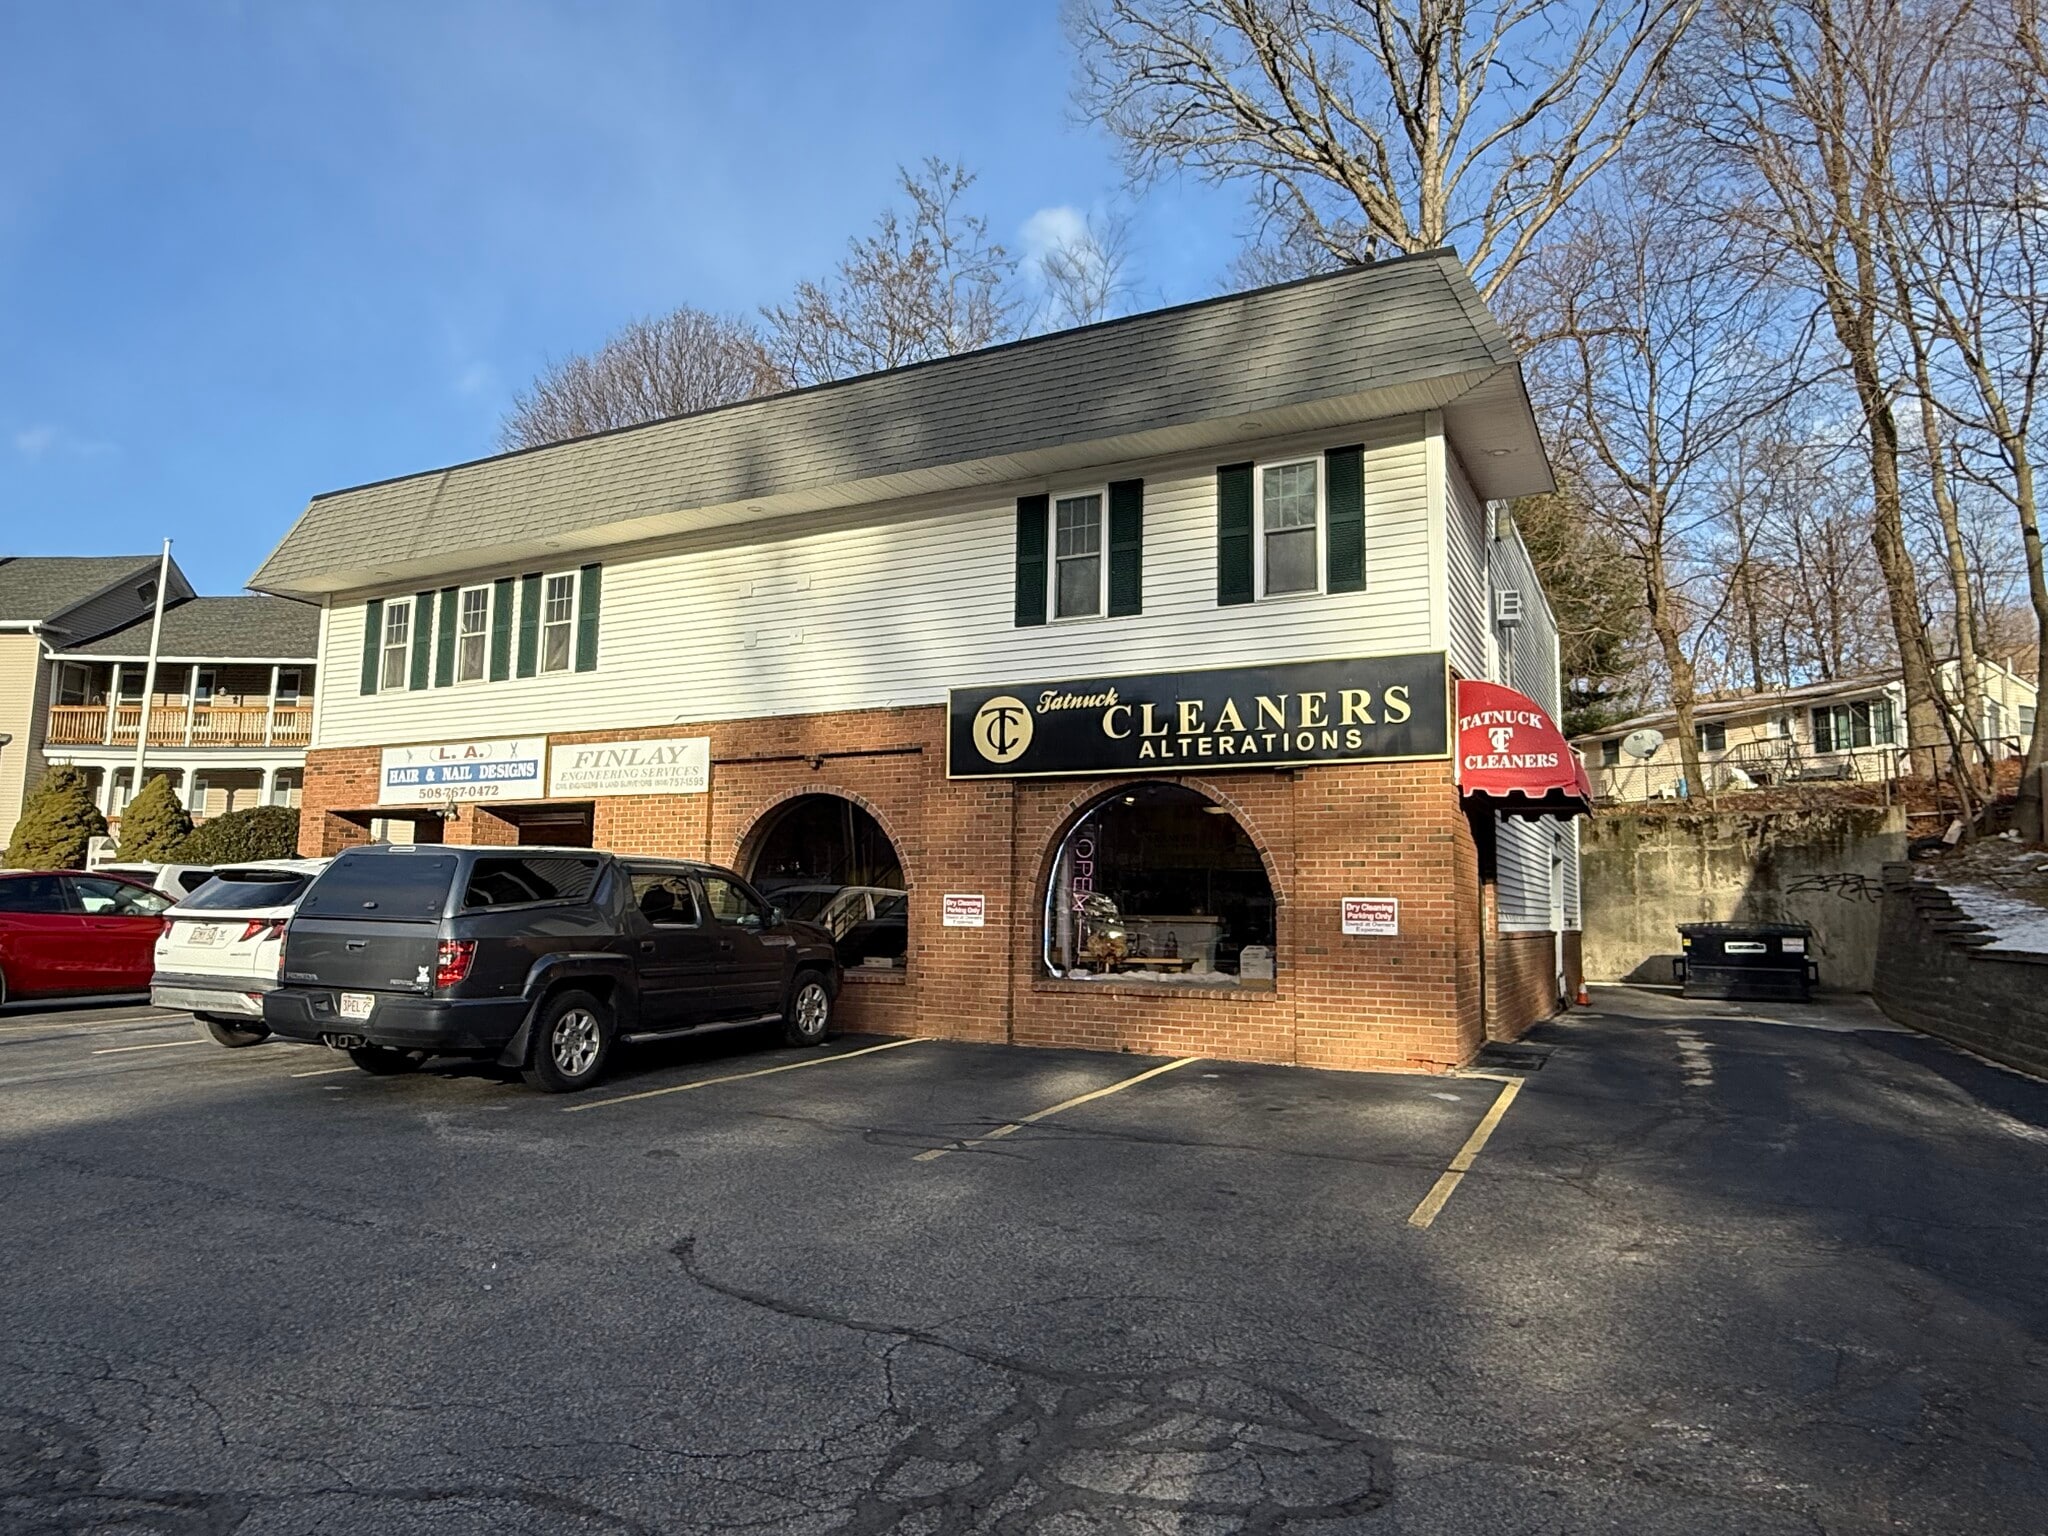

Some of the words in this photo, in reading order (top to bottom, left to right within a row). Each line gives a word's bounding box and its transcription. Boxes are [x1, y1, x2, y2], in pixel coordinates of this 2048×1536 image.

[1036, 687, 1118, 713] Tatnuck
[1102, 685, 1412, 739] CLEANERS
[1460, 710, 1543, 732] TATNUCK
[1139, 728, 1363, 758] ALTERATIONS
[572, 745, 689, 769] FINLAY
[1464, 753, 1558, 769] CLEANERS
[389, 769, 419, 784] HAIR
[425, 768, 435, 781] &
[442, 765, 472, 781] NAIL
[479, 762, 535, 779] DESIGNS
[560, 768, 639, 781] ENGINEERING
[640, 765, 699, 778] SERVICES
[1072, 838, 1096, 912] OPEN
[1346, 903, 1360, 912] Dry
[1375, 912, 1392, 921] Only
